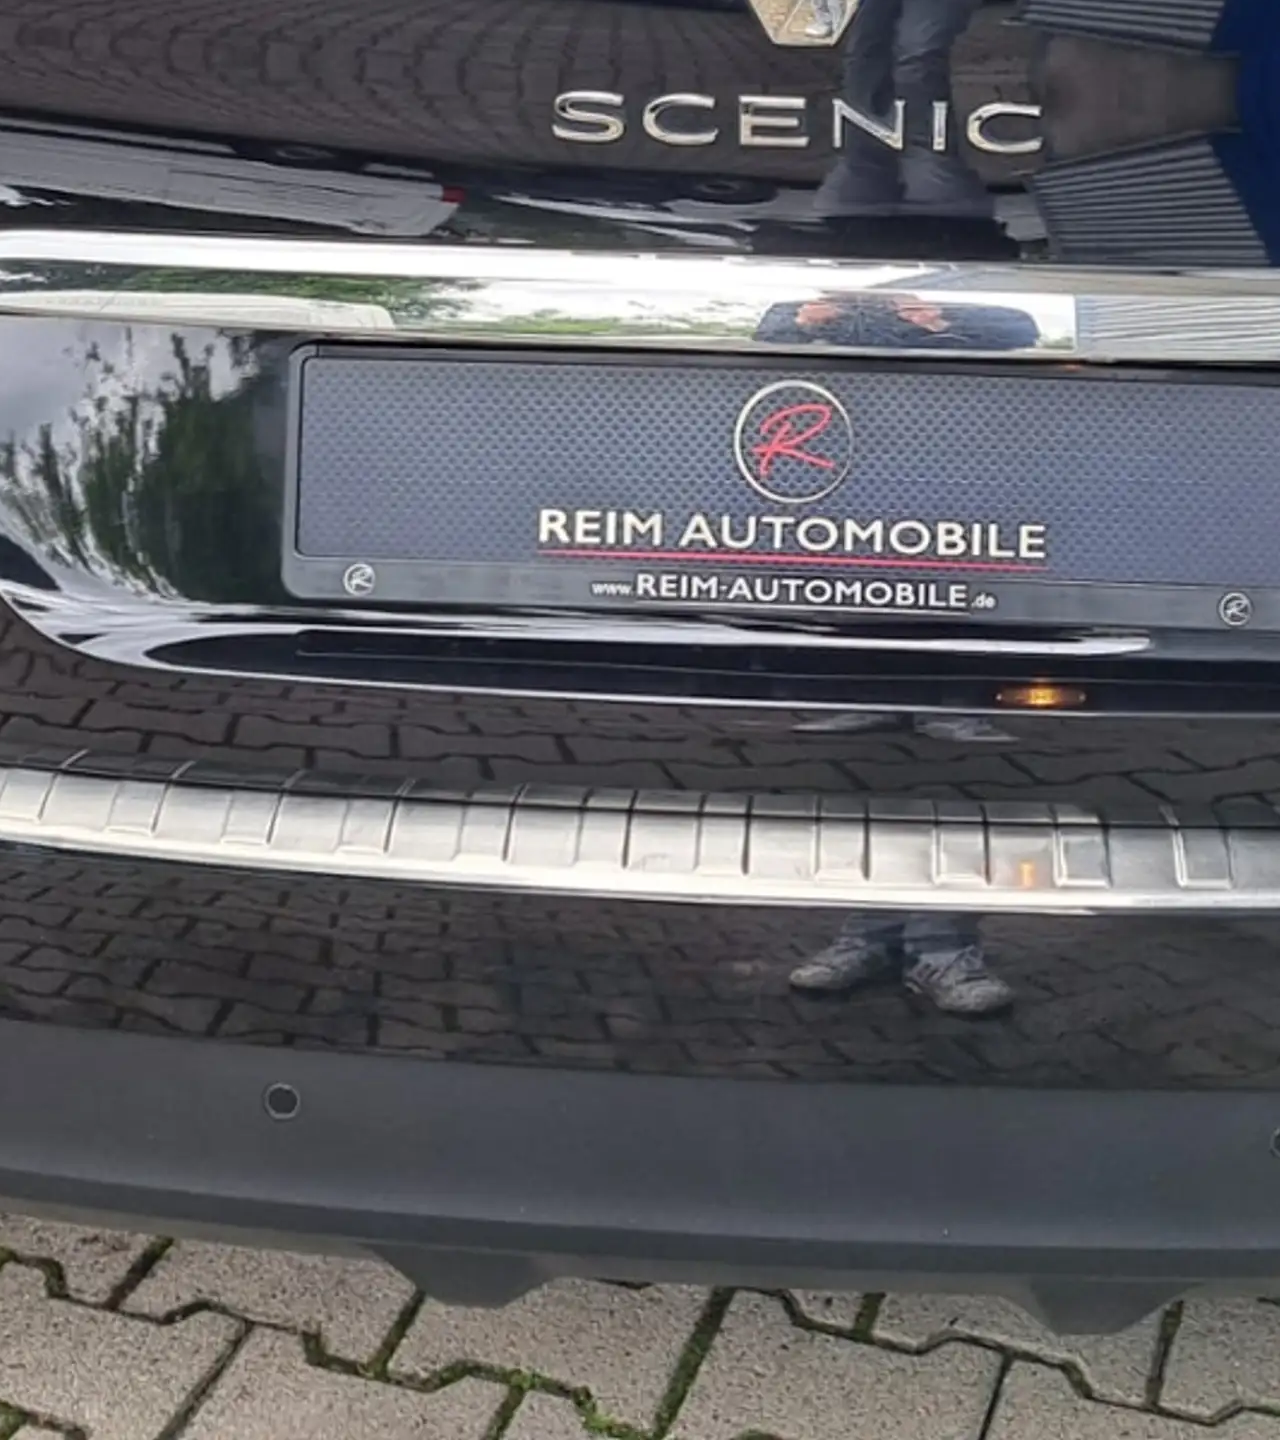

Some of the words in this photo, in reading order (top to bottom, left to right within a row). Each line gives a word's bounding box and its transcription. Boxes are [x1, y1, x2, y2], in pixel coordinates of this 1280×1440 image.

[551, 89, 1044, 153] SCENIC
[537, 508, 662, 547] REIM
[679, 512, 1047, 559] AUTOMOBILE
